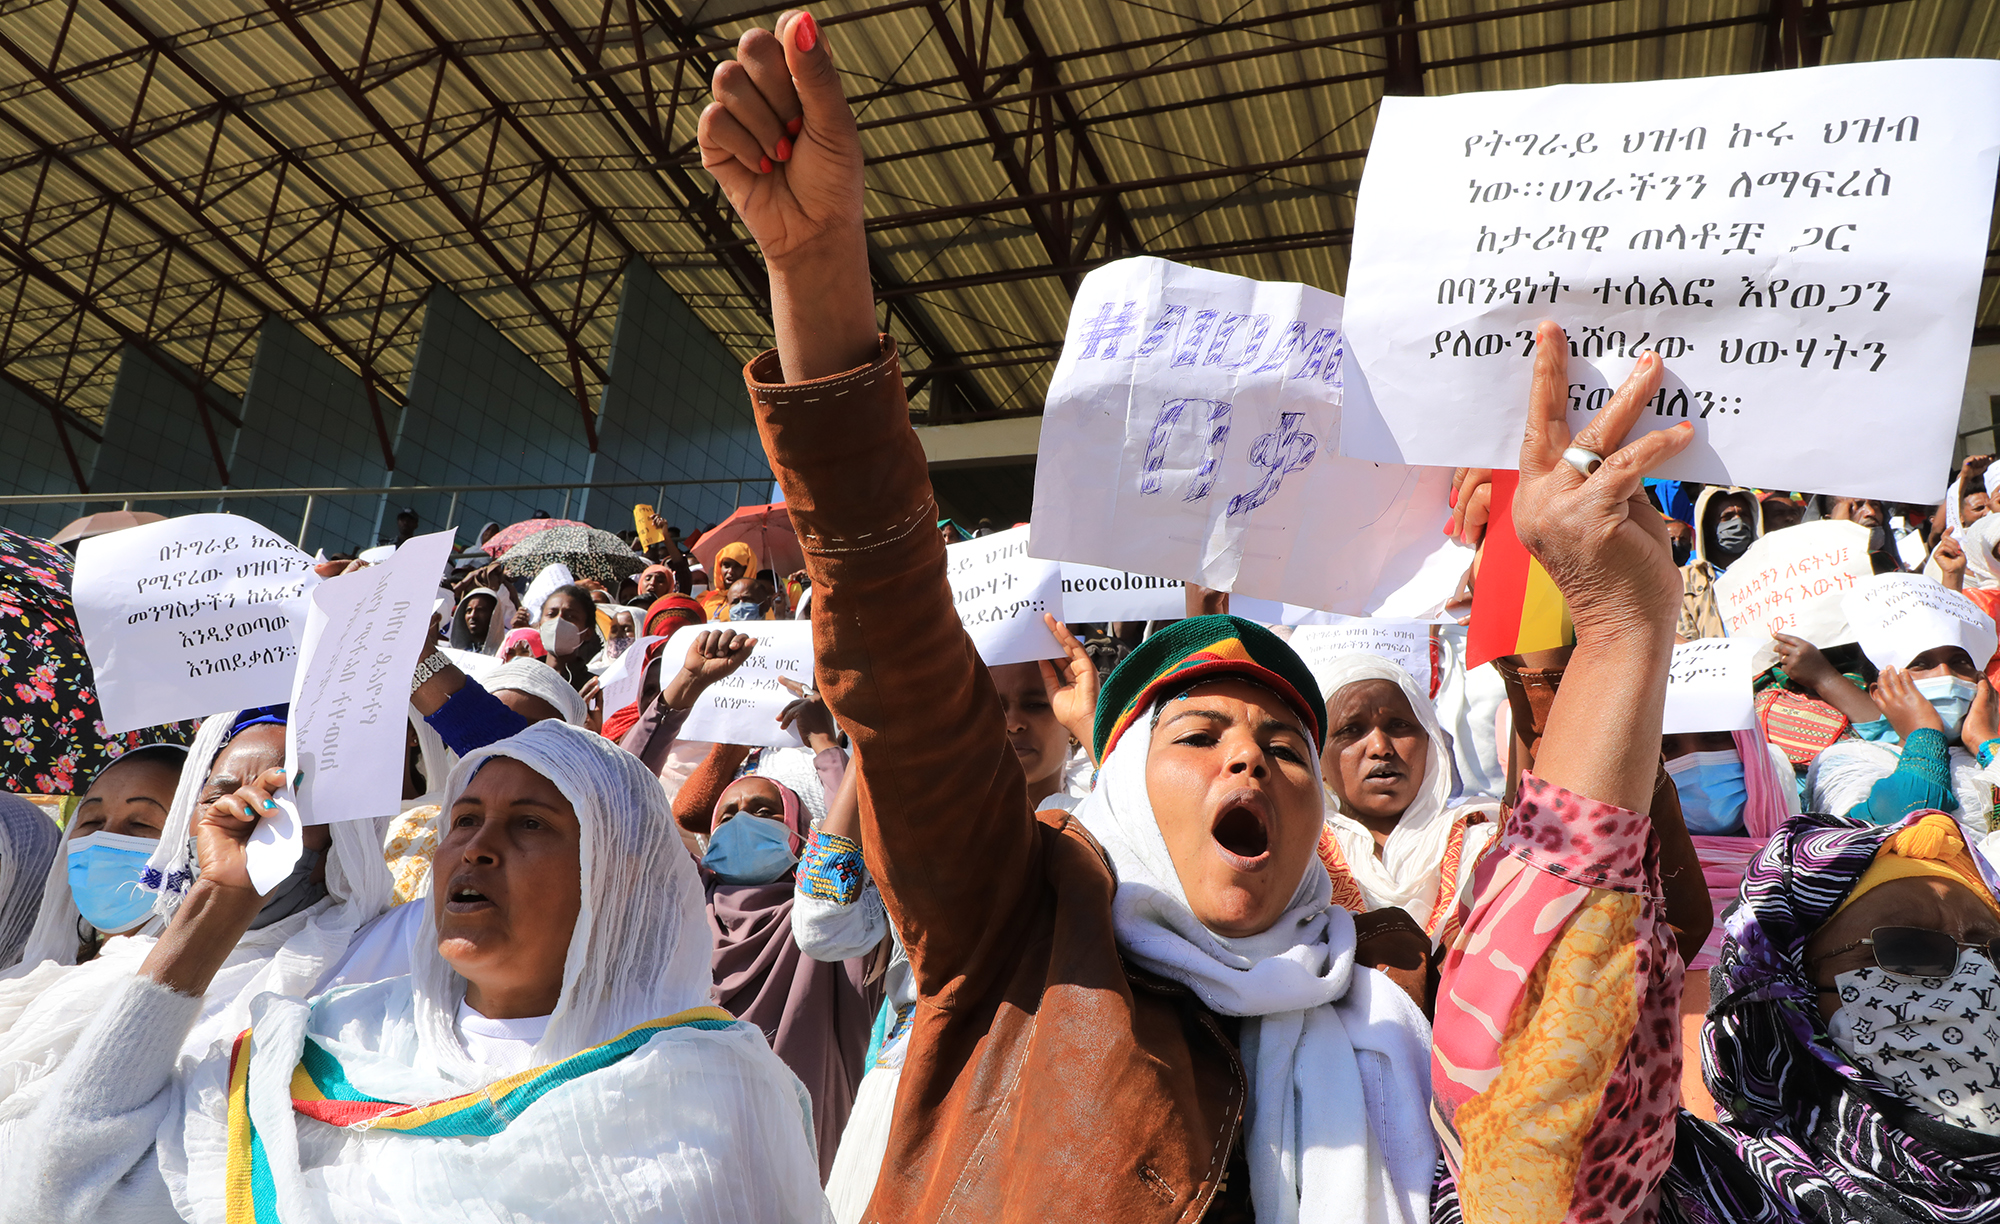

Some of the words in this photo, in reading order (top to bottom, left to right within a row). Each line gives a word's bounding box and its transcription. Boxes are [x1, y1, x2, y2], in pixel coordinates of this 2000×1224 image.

[1465, 130, 1598, 158] የትግራይ
[1623, 127, 1706, 153] ህዝብ
[1729, 122, 1793, 148] ኩሩ
[1824, 116, 1919, 143] ህዝብ
[1729, 168, 1890, 198] ለማፍረስ
[1477, 225, 1609, 254] ከታሪካዊ
[1790, 224, 1856, 252] ጋር
[1438, 271, 1569, 304] በባንዳነት
[1593, 276, 1714, 307] ተሰልፎ
[1739, 276, 1890, 312] እየወጋን
[1430, 330, 1535, 359] ያለውን
[1721, 334, 1887, 372] ህውሃትን
[159, 534, 240, 562] በትግራይ
[136, 566, 224, 594] የሚኖረው
[235, 555, 316, 579] ህዝባችን
[126, 590, 236, 626] መንግስታችን
[178, 614, 290, 649] እንዲያወጣው
